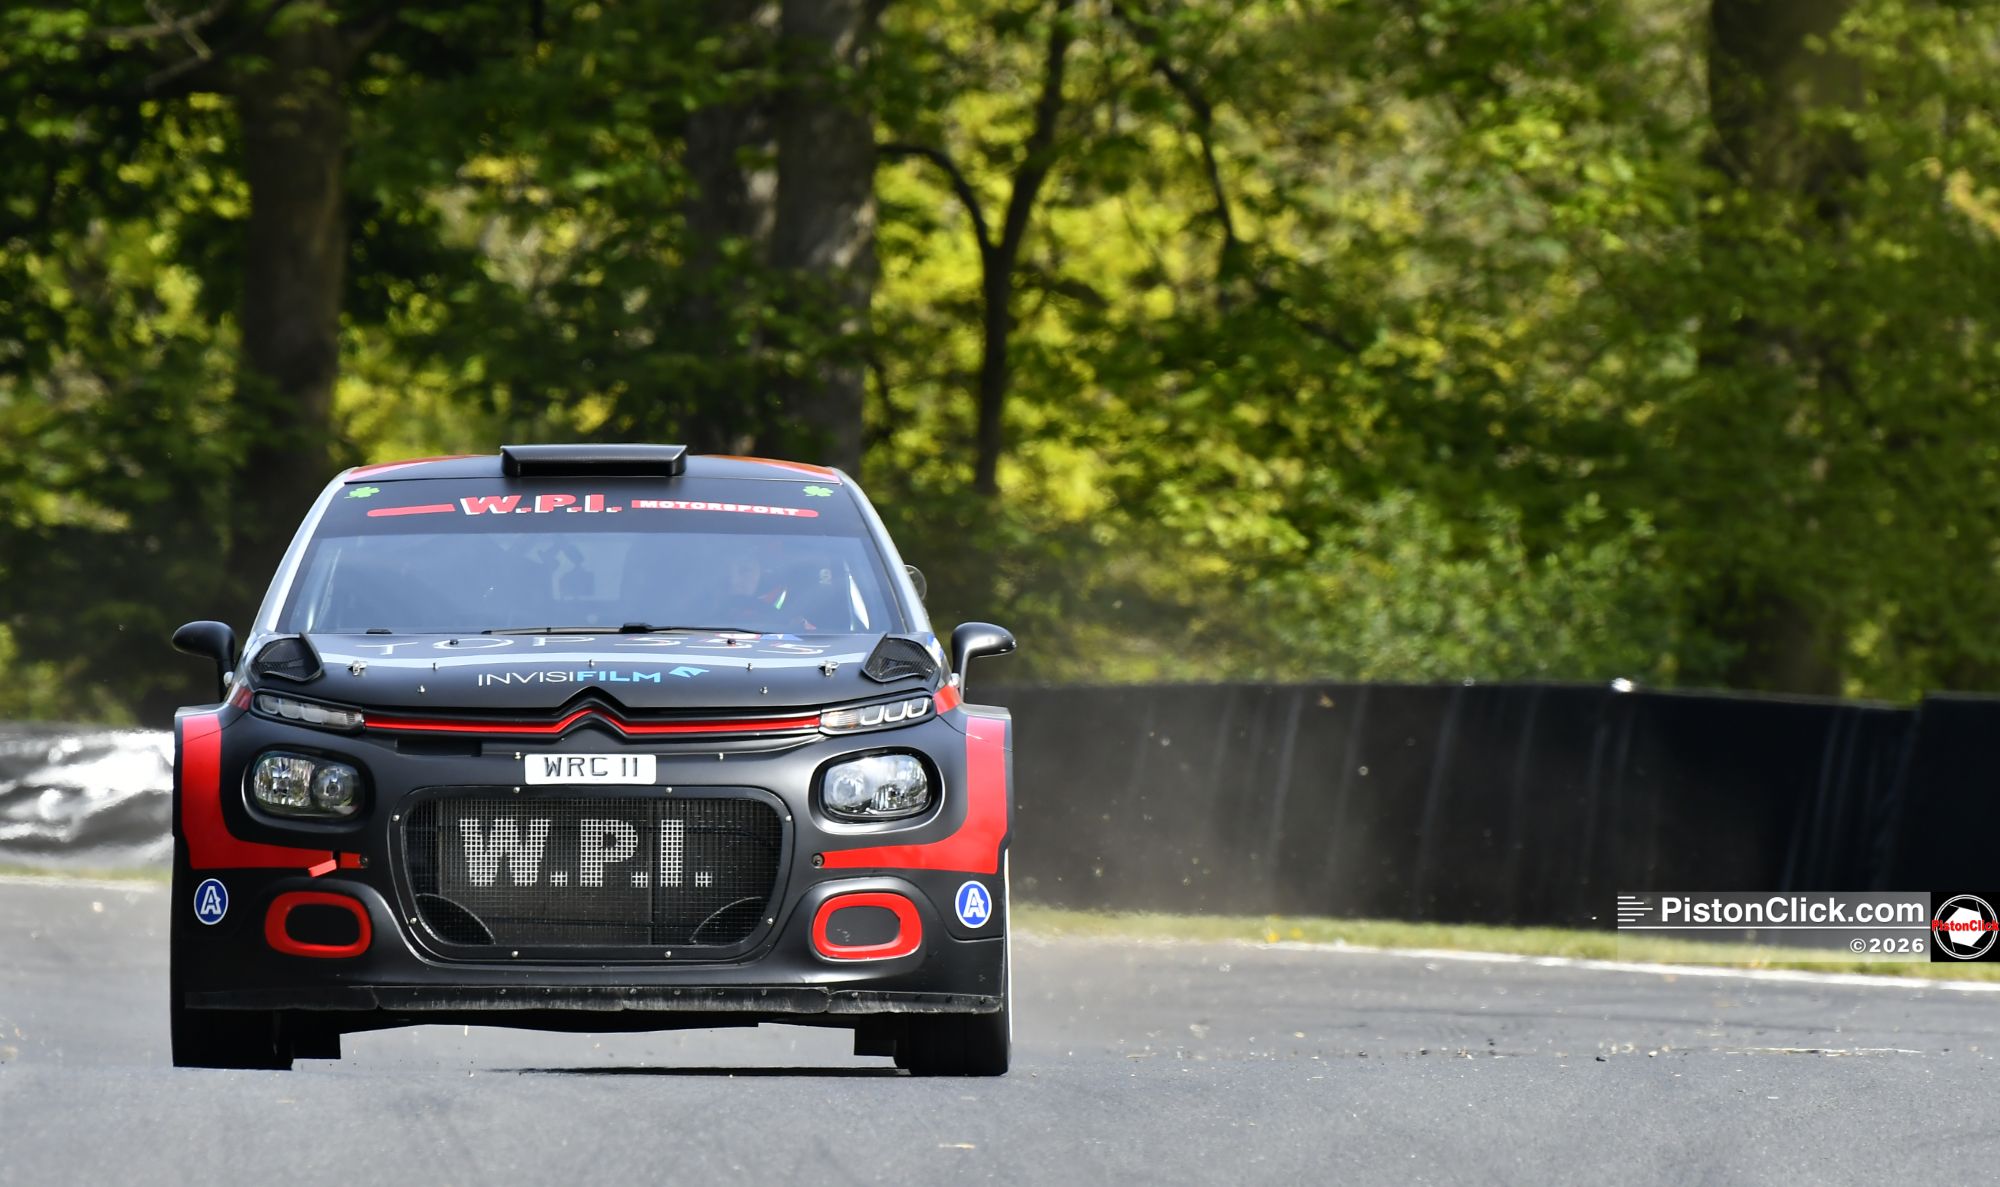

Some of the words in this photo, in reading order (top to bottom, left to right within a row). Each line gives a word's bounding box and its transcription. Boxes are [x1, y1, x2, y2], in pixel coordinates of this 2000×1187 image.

[460, 494, 623, 515] W.P.I.
[640, 500, 799, 516] MOTORSPORT
[478, 670, 661, 687] INVISIFILM
[543, 757, 608, 777] WRC
[459, 818, 712, 887] W.P.I.
[200, 885, 222, 915] A
[962, 887, 987, 918] A
